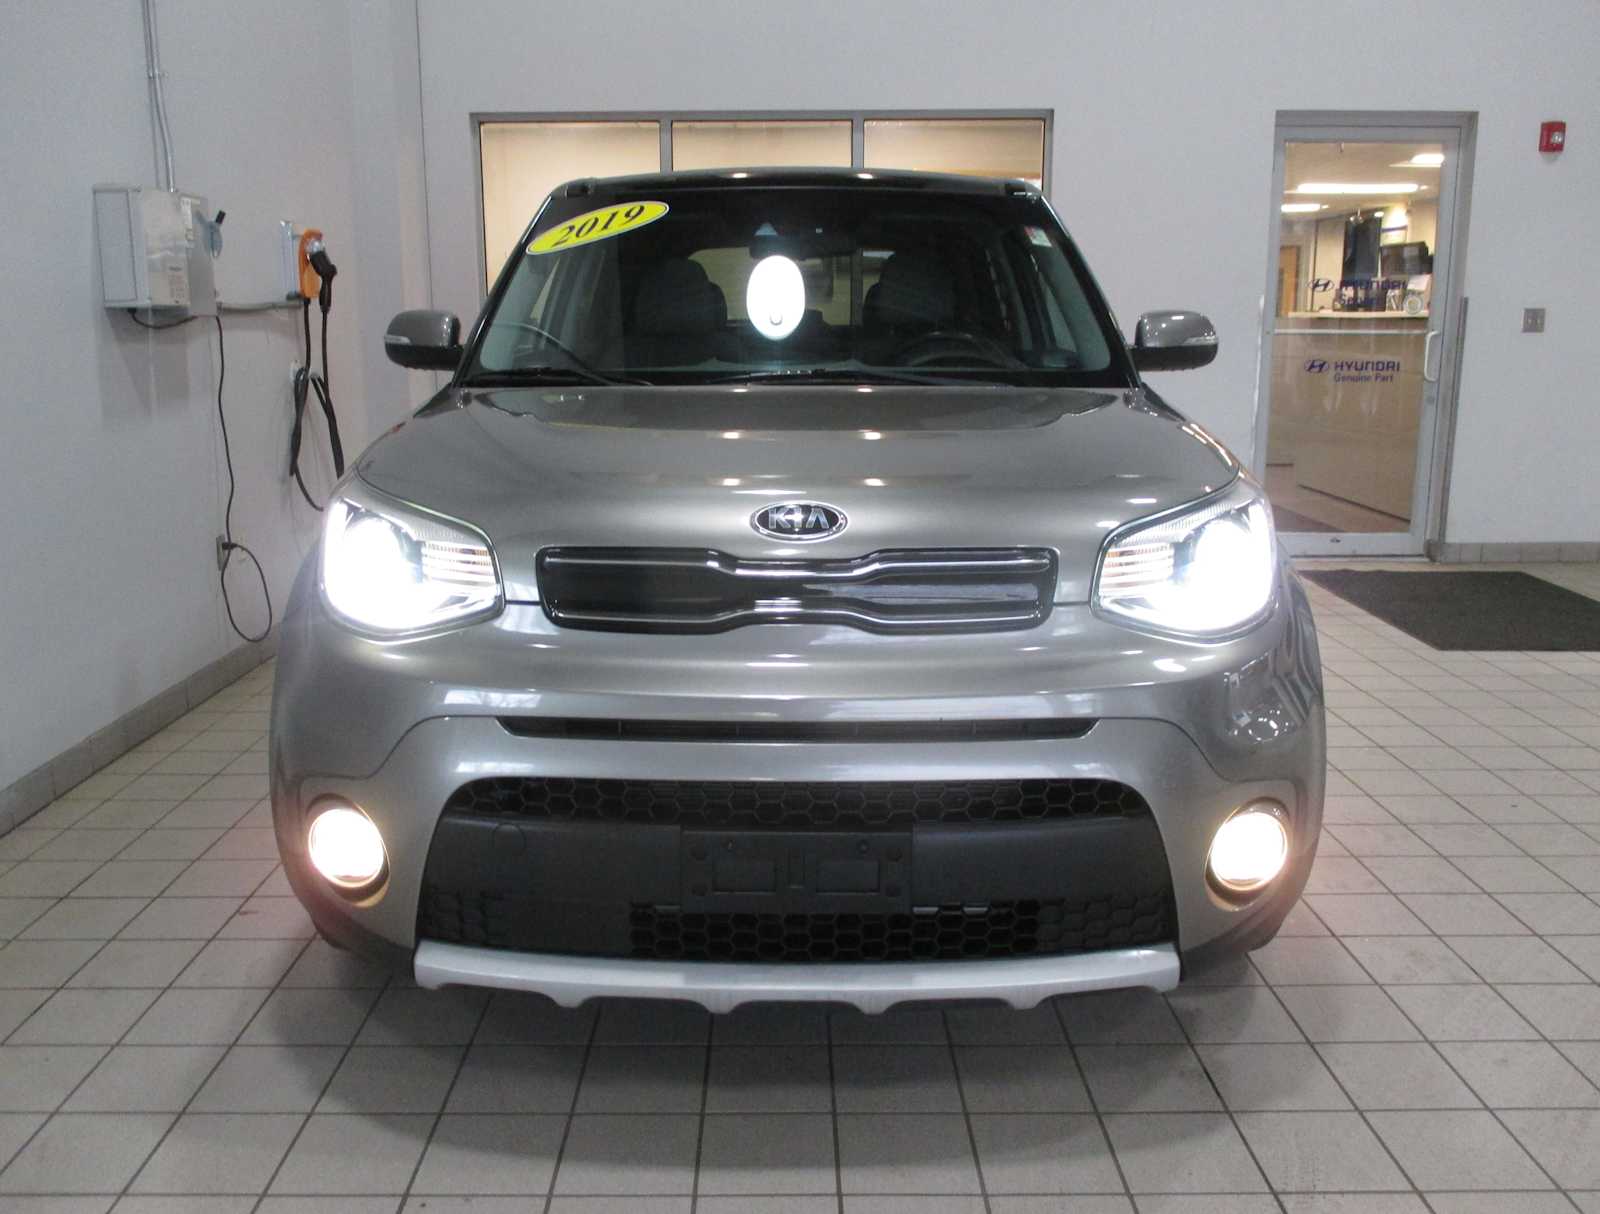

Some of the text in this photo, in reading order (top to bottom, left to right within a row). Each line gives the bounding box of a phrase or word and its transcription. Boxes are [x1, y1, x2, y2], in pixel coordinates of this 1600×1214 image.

[551, 205, 645, 247] 2019
[1334, 361, 1400, 371] HYUNDAI
[1334, 373, 1370, 382] Genuine
[768, 505, 829, 529] KIA
